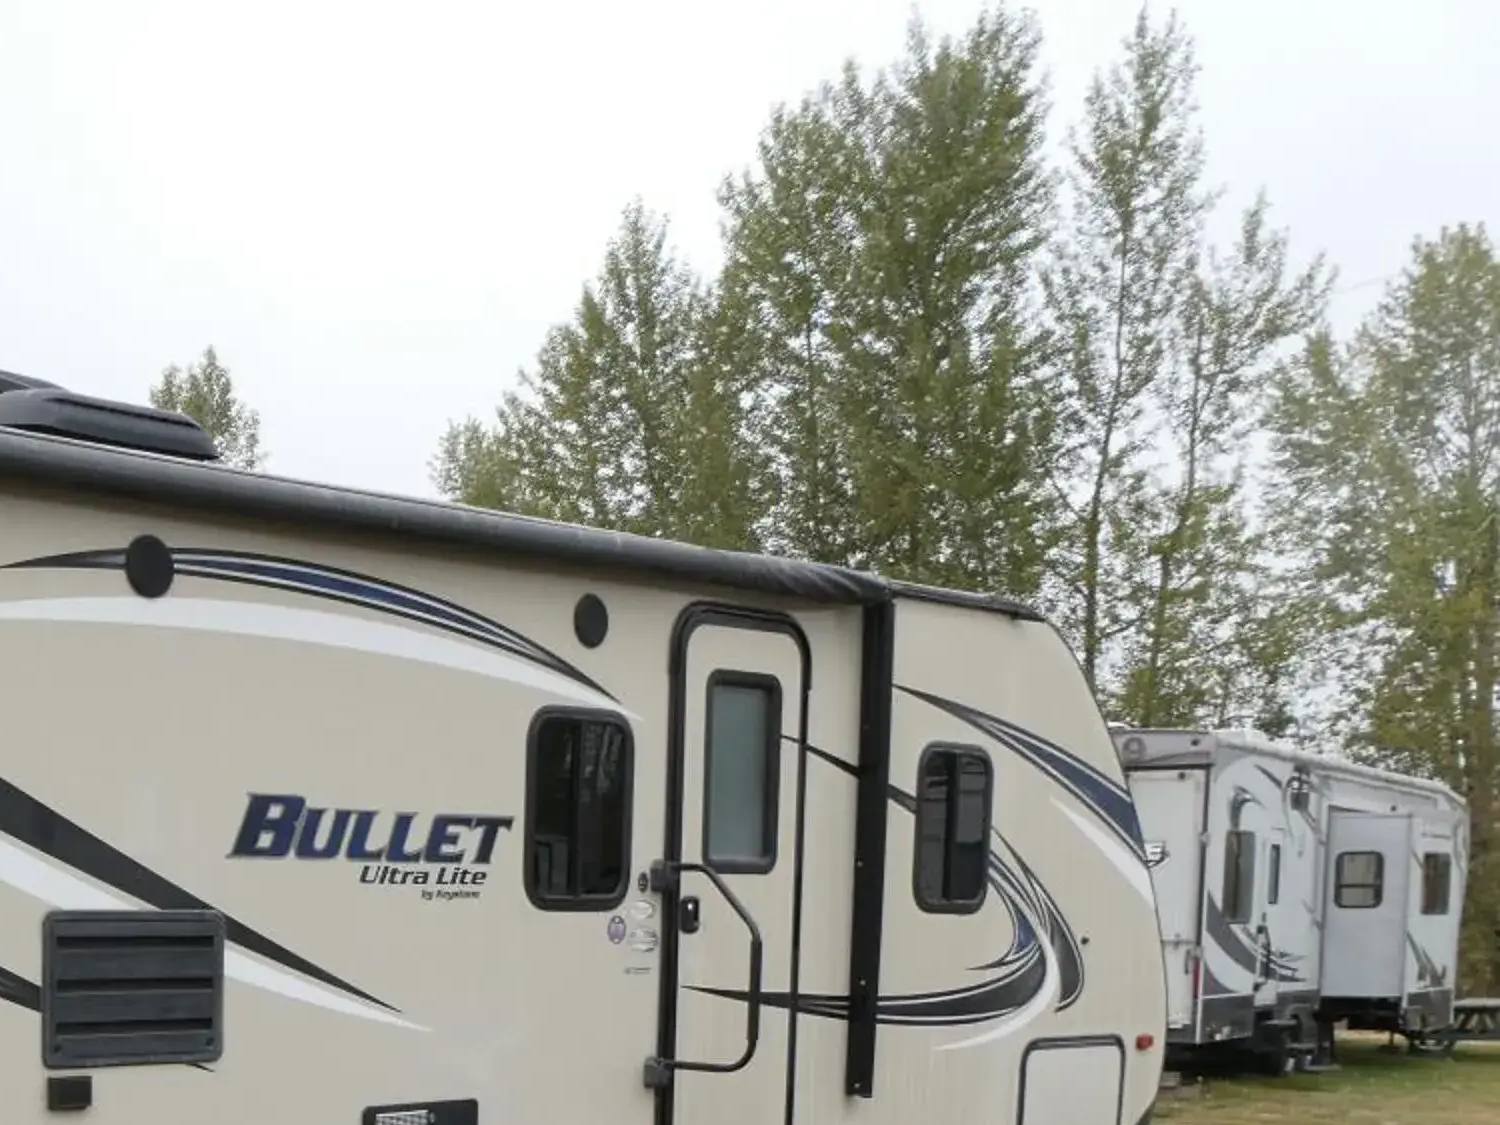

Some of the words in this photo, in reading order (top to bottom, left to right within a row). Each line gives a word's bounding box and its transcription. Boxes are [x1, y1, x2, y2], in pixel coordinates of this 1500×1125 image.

[225, 792, 514, 864] BULLET
[359, 865, 429, 885] Ultra
[436, 866, 487, 885] Lite
